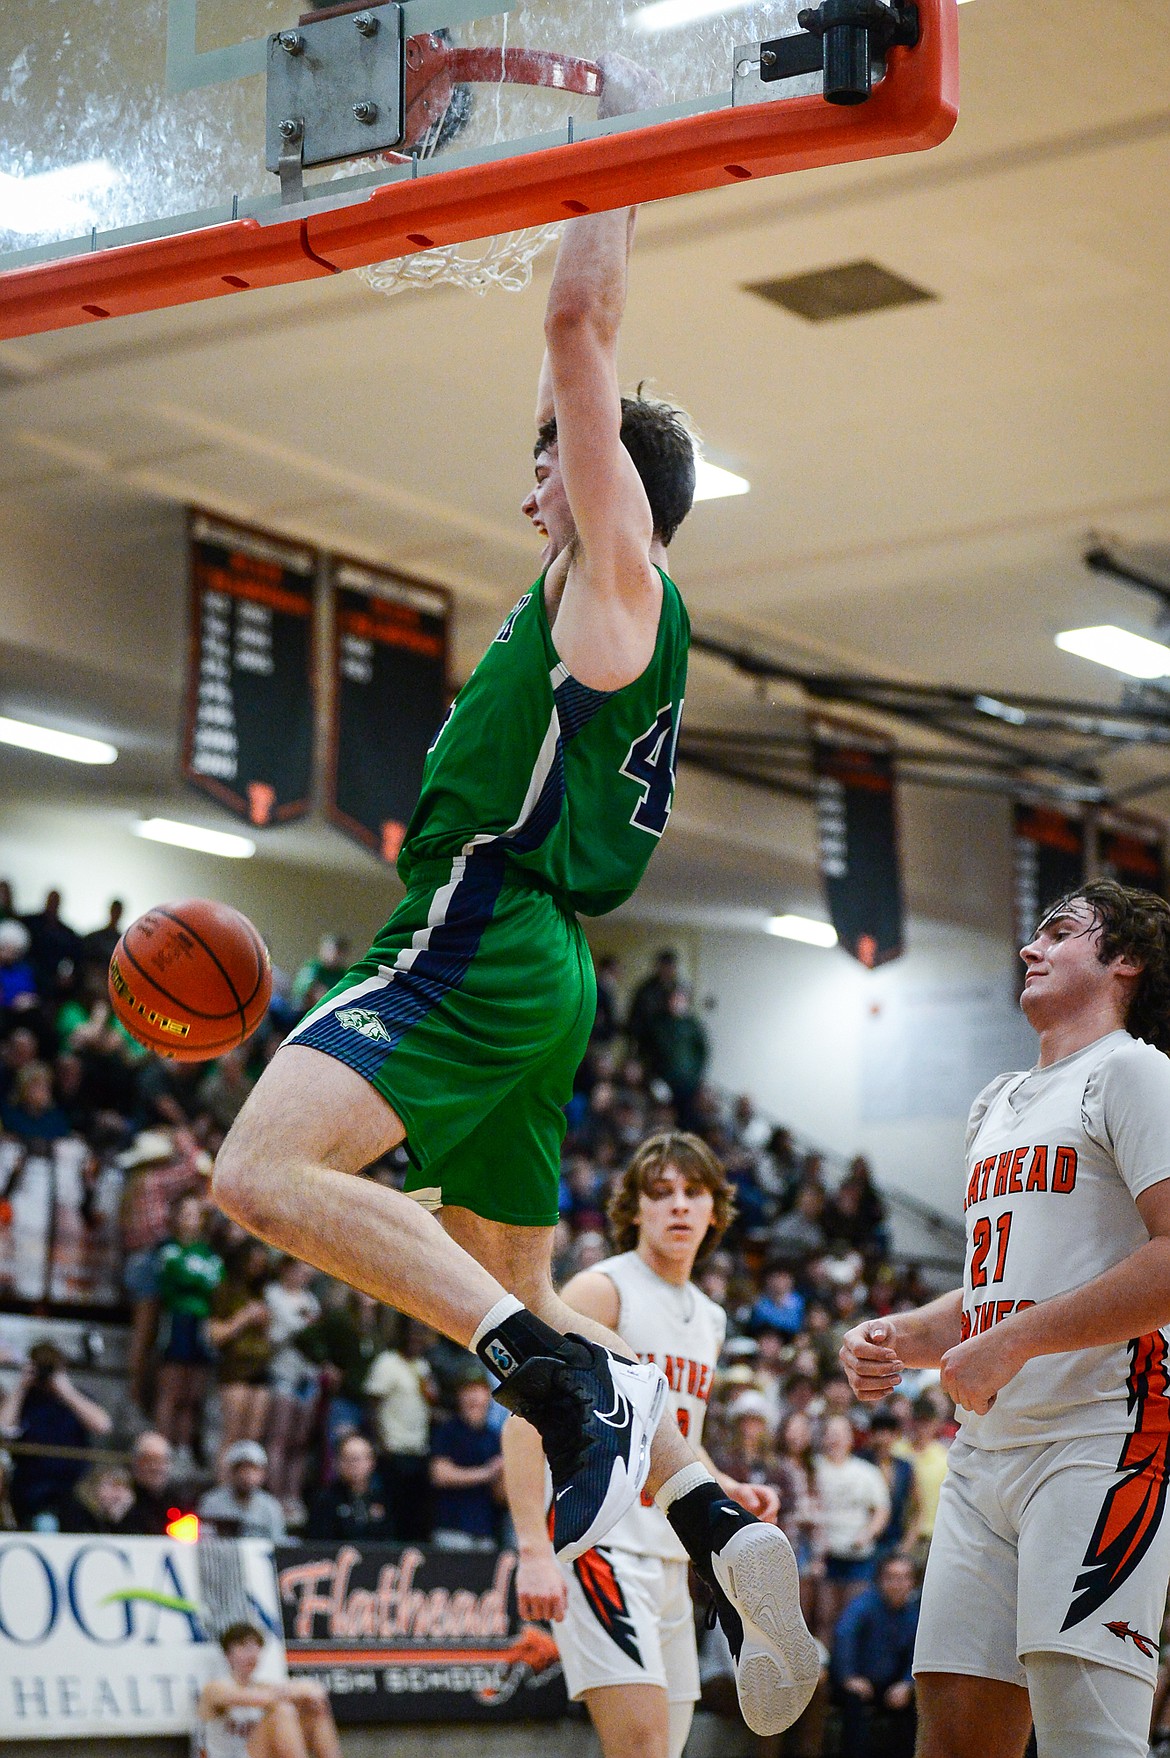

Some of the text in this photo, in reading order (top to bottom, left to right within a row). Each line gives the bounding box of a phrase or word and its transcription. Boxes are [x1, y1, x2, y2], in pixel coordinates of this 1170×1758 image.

[964, 1145, 1078, 1212] ATHEAD
[971, 1211, 1012, 1290] 21
[278, 1546, 517, 1639] Flathead
